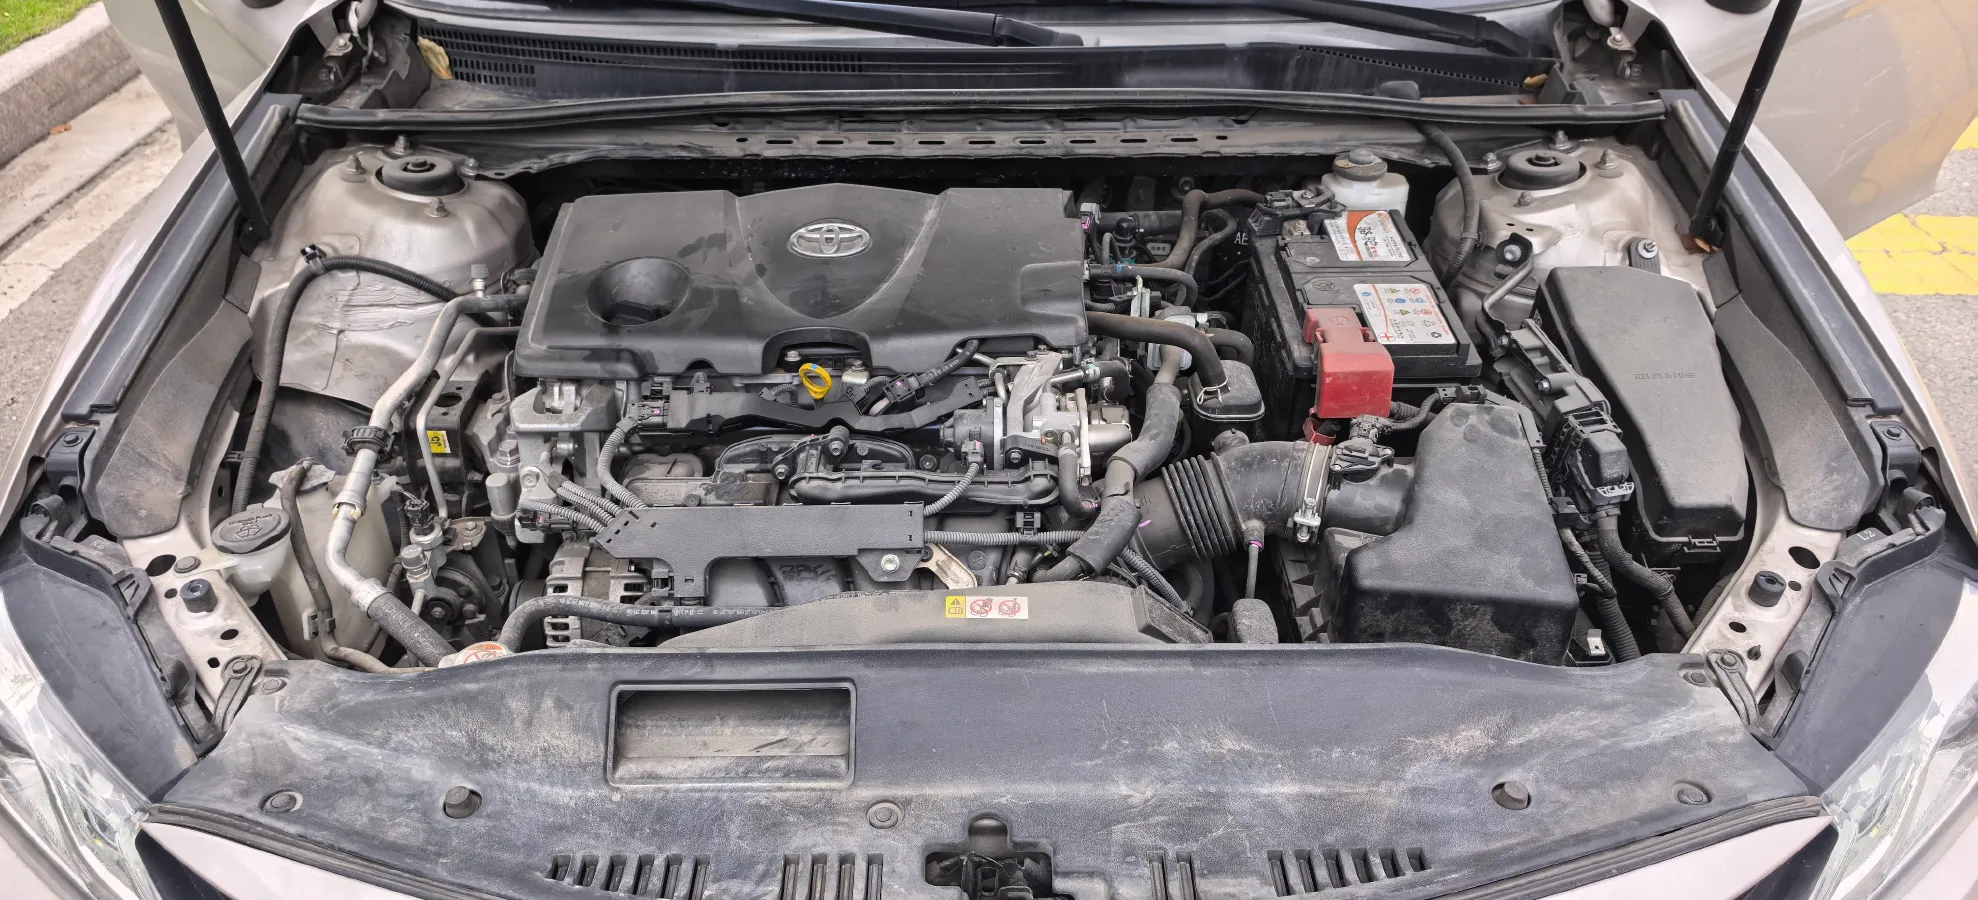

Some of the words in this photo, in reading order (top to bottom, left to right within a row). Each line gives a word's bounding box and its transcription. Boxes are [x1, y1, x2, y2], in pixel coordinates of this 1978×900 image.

[1633, 372, 1663, 380] RELAY
[1673, 371, 1697, 379] FUSE
[1857, 530, 1876, 541] L2
